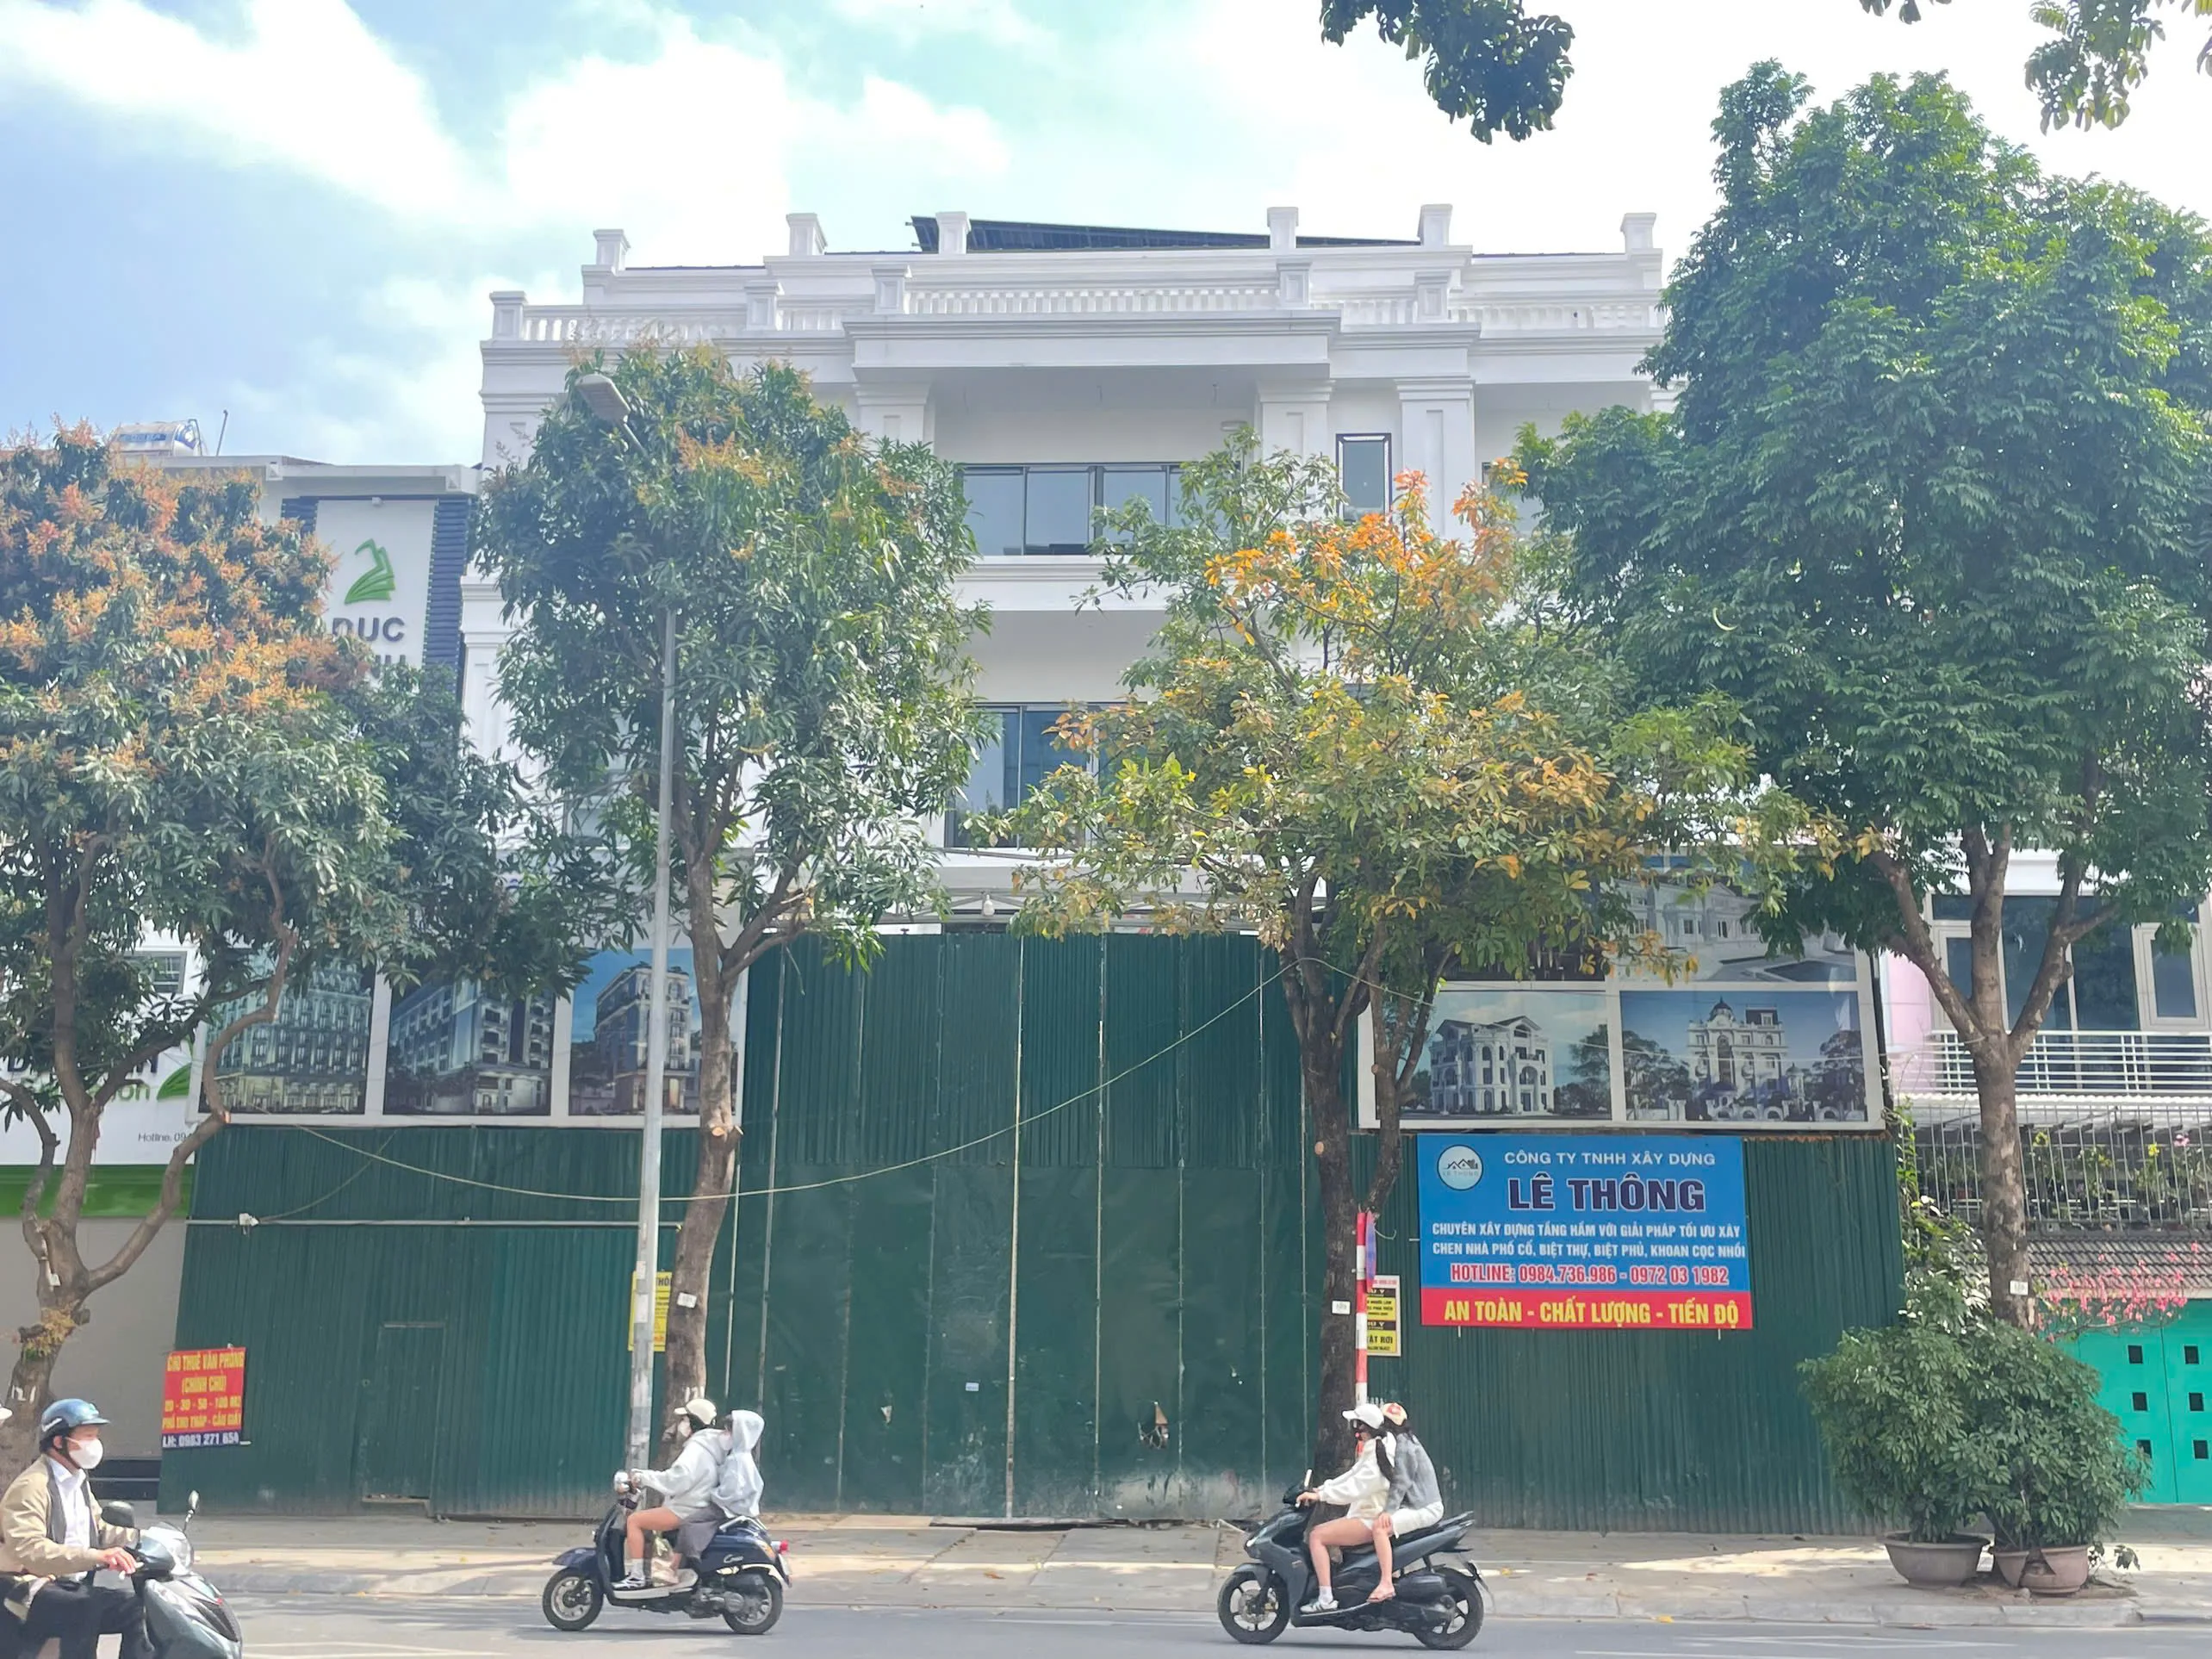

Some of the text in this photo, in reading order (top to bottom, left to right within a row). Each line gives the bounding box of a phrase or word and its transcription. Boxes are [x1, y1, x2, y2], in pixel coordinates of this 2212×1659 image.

[1505, 1149, 1716, 1167] CÔNG TY TNHH XÂY DỰNG
[1508, 1171, 1706, 1212] LÊ THÔNG
[1432, 1221, 1476, 1235] CHUYÊN
[1480, 1221, 1501, 1235] XÂY
[1504, 1222, 1535, 1239] DỰNG
[1646, 1222, 1675, 1238] PHÁP
[1679, 1221, 1697, 1237] TỐI
[1700, 1224, 1715, 1238] ƯU
[1718, 1223, 1741, 1238] XÂY
[1432, 1242, 1463, 1255] CHEN
[1466, 1240, 1489, 1255] NHÀ
[1539, 1241, 1563, 1258] BIỆT
[1594, 1241, 1619, 1258] BIỆT
[1650, 1244, 1689, 1258] KHOAN
[1693, 1244, 1717, 1260] CỌC
[1451, 1263, 1516, 1283] HOTLINE:
[1519, 1264, 1617, 1284] 0984.736.986
[1630, 1265, 1668, 1285] 0972
[1670, 1265, 1689, 1285] 03
[1692, 1265, 1730, 1285] 1982
[1445, 1300, 1469, 1321] AN
[1474, 1296, 1522, 1322] TOÀN
[1539, 1296, 1586, 1323] CHẤT
[1591, 1300, 1650, 1327] LƯỢNG
[1668, 1297, 1709, 1324] TIẾN
[1714, 1299, 1738, 1328] ĐỘ
